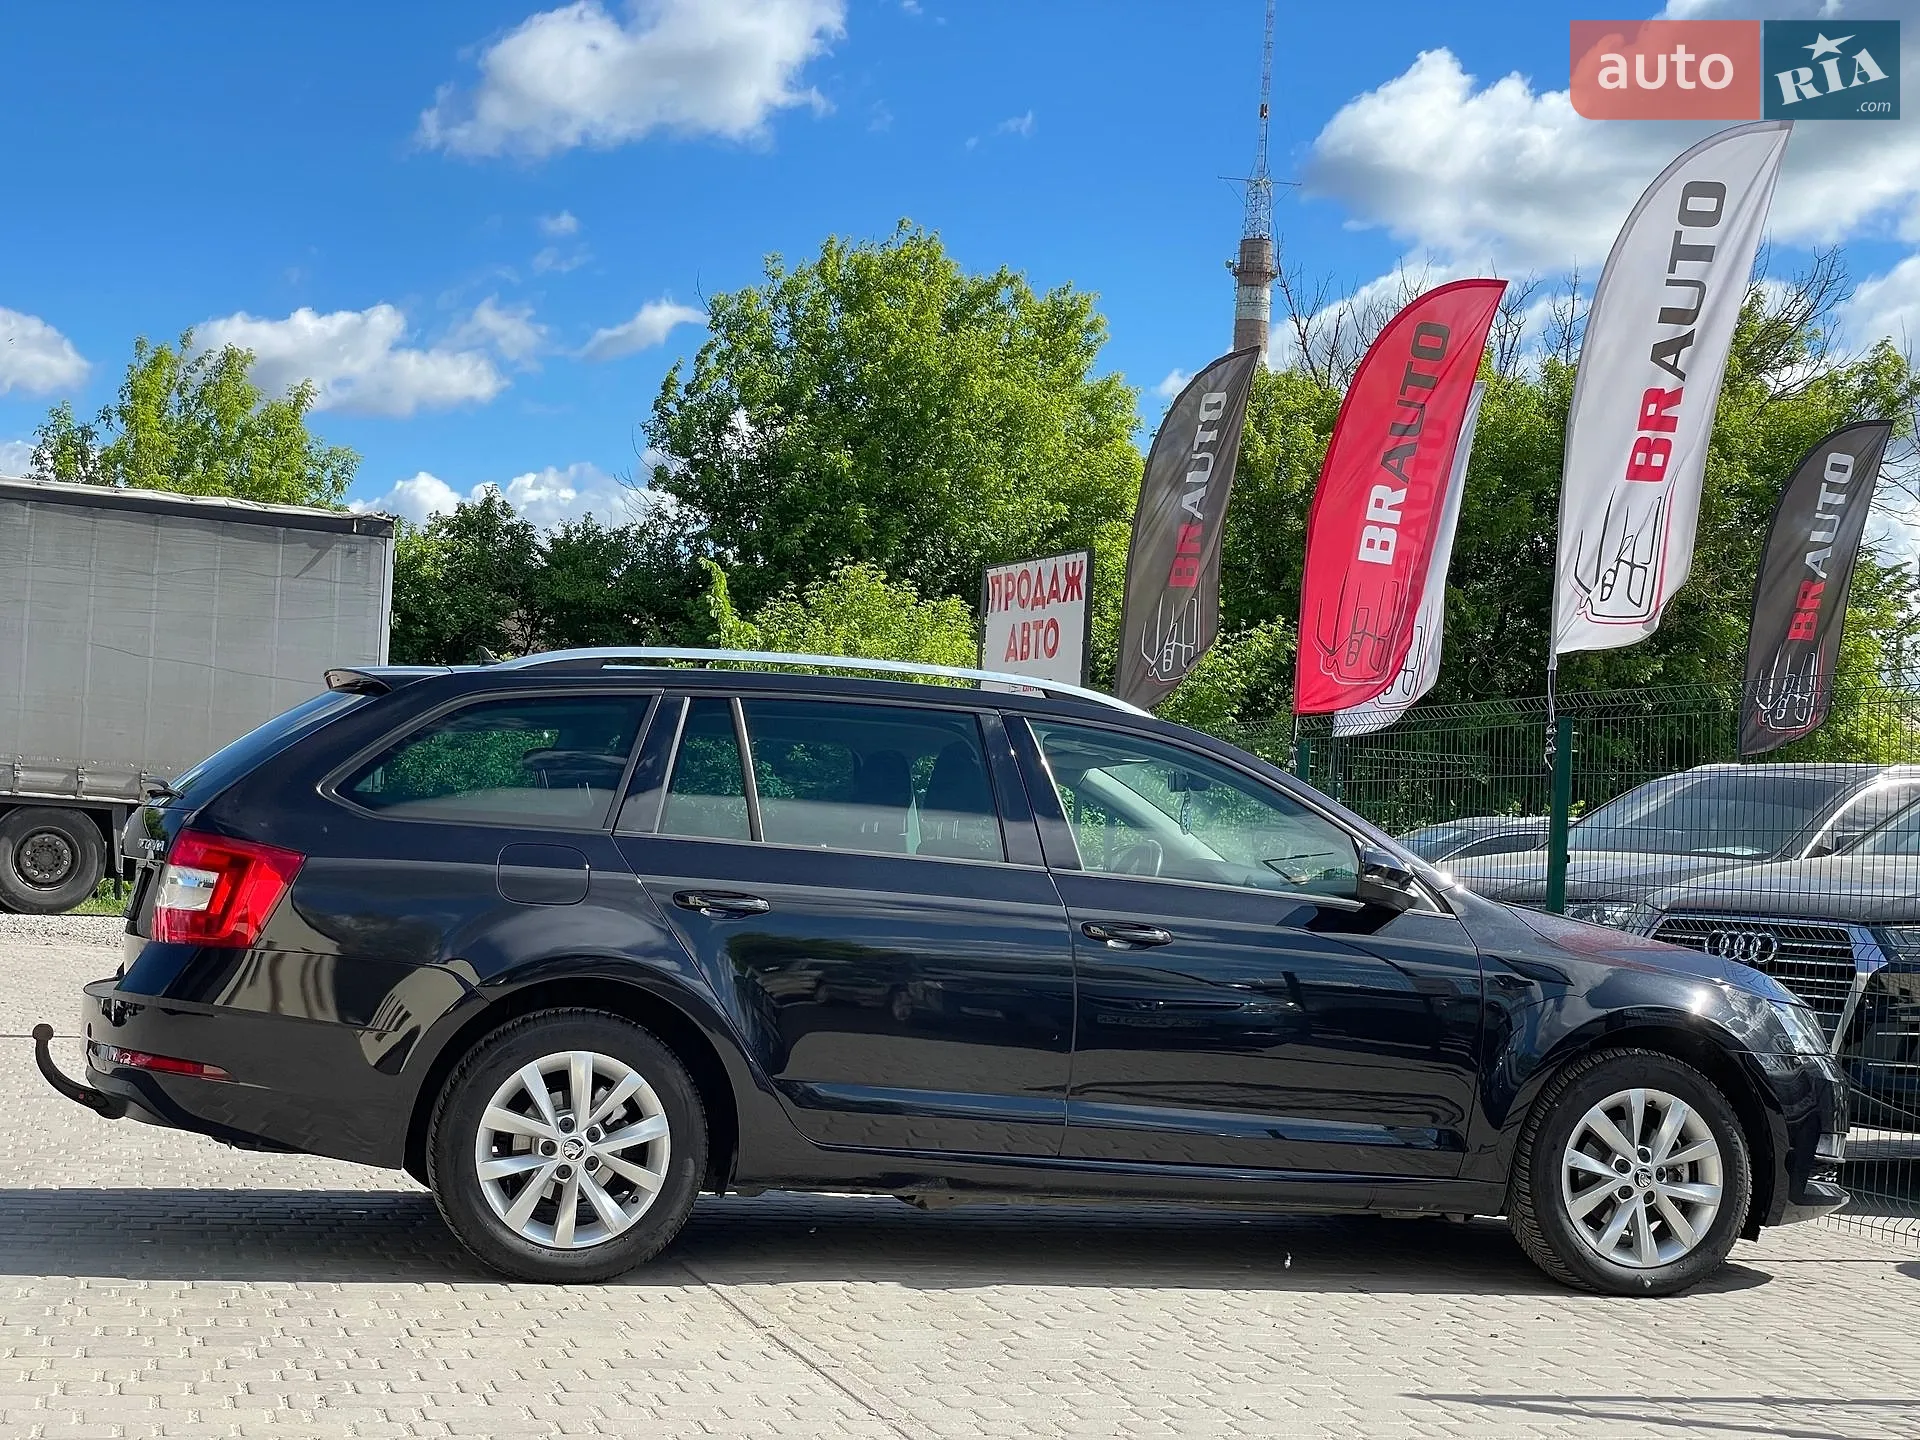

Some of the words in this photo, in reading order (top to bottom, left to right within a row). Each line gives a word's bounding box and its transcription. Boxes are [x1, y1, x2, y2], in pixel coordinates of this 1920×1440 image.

[1626, 180, 1728, 483] BRAUTO
[1168, 391, 1228, 589] BRAUTO
[1358, 321, 1452, 566] BRAUTO
[990, 560, 1084, 613] ПРОДАЖ
[1004, 617, 1060, 662] АВТО
[1788, 452, 1855, 640] BRAUTO
